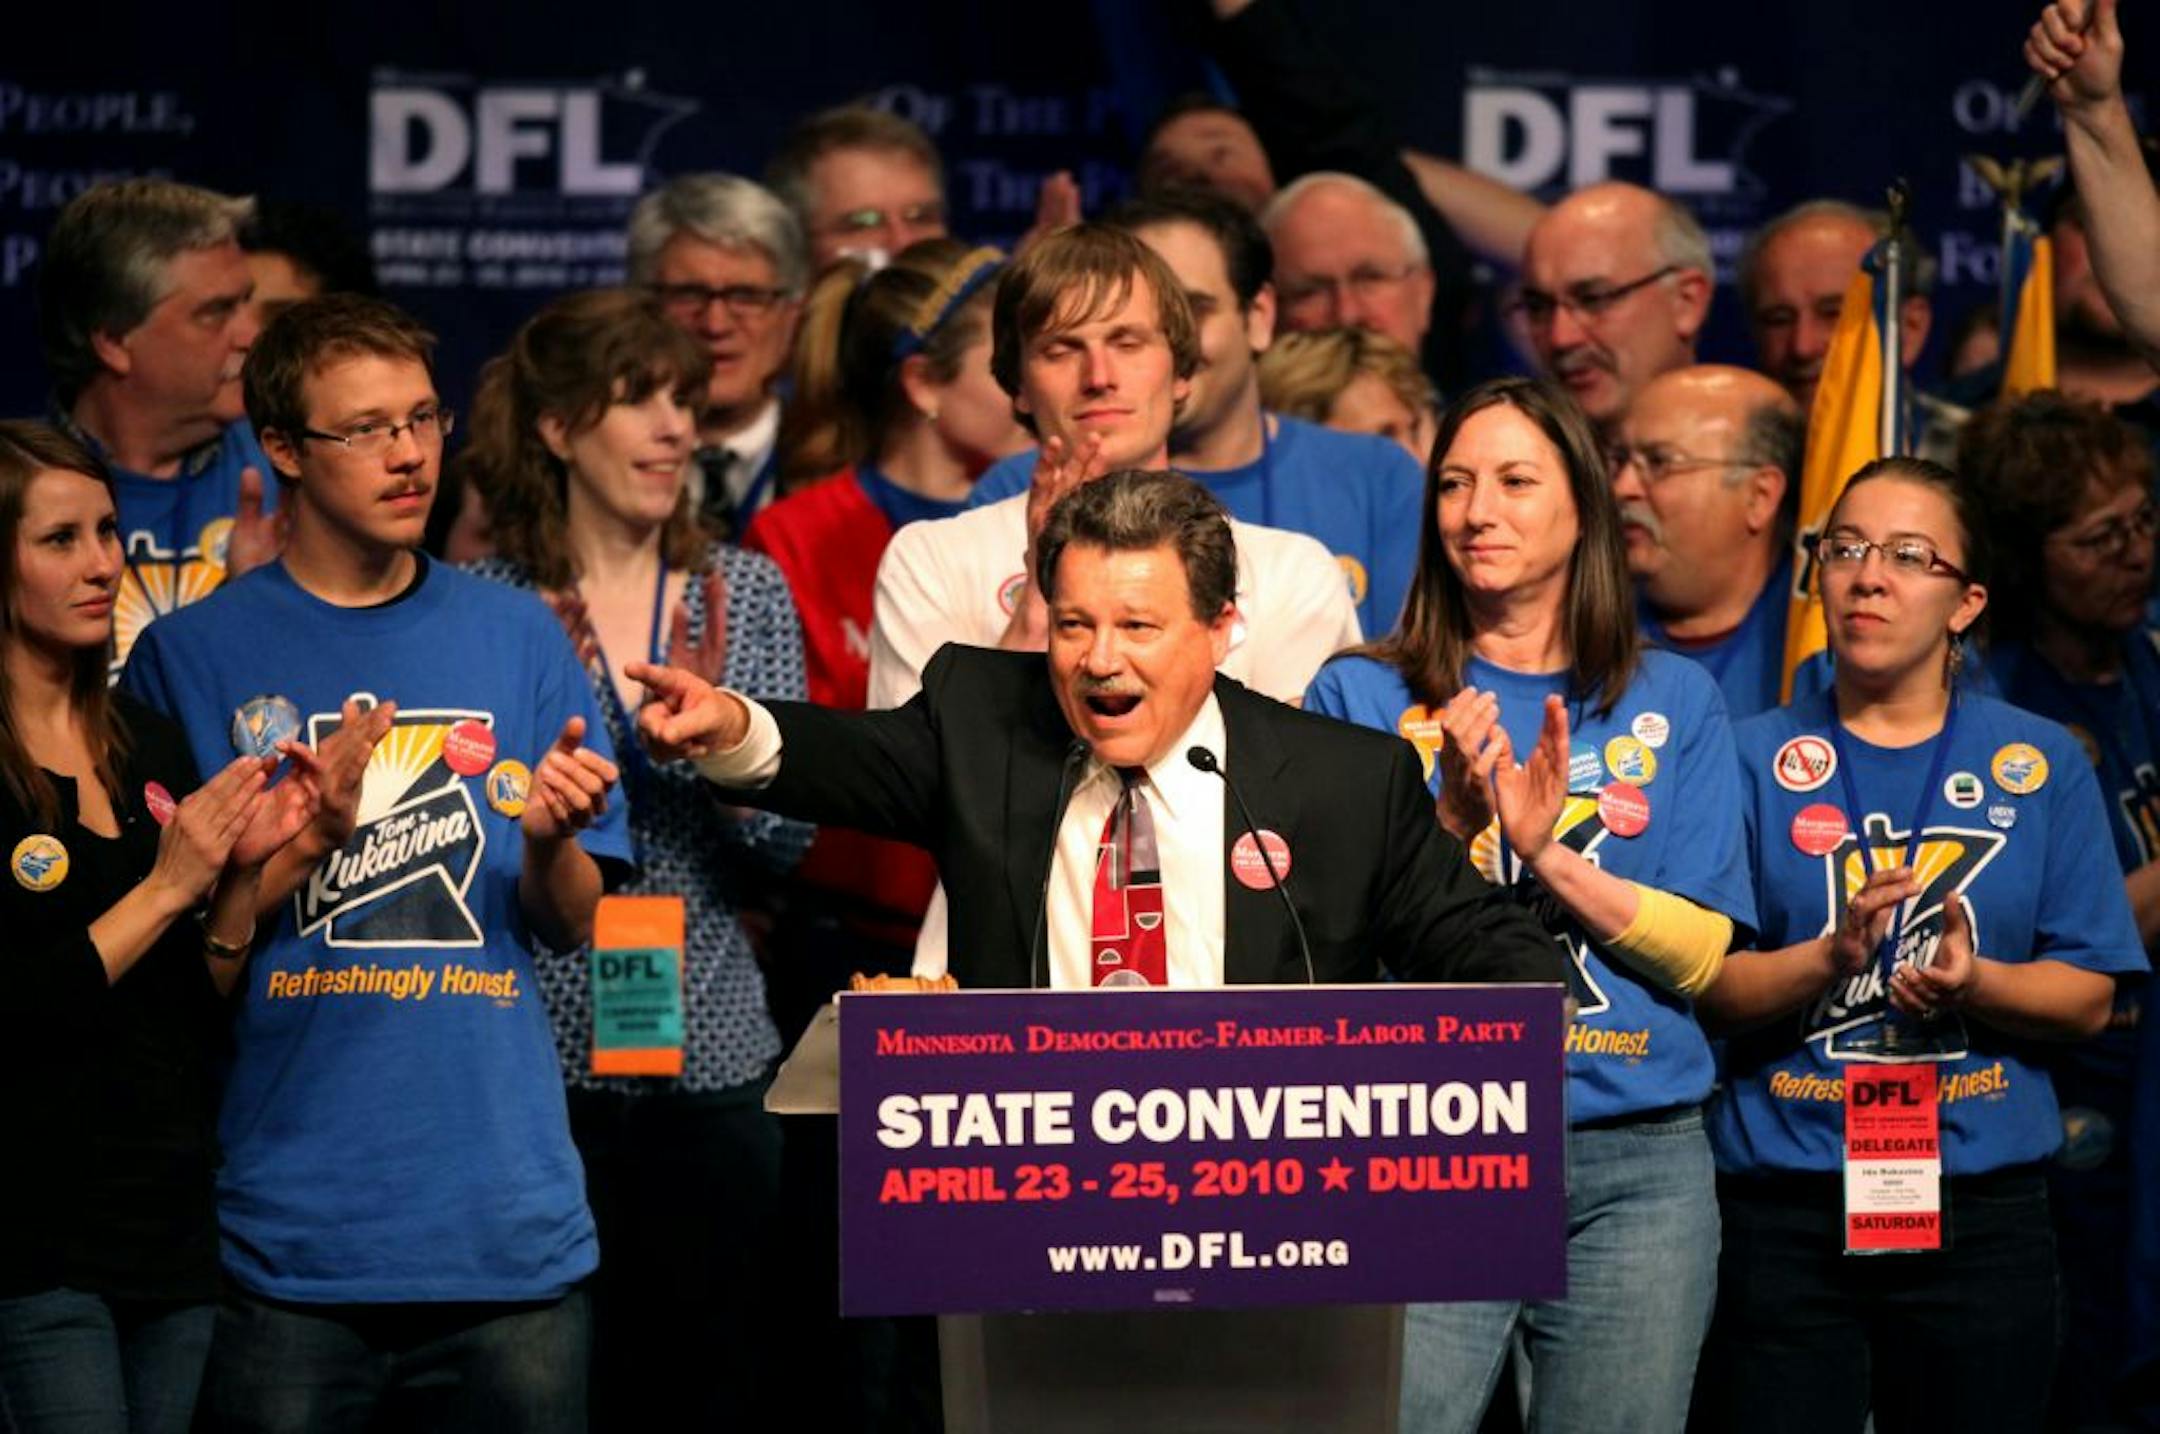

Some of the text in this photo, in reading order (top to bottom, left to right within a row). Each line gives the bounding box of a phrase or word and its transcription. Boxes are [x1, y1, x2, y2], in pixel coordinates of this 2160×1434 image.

[370, 88, 645, 195] DFL
[1464, 87, 1736, 195] DFL
[600, 955, 662, 980] DFL
[877, 1016, 1526, 1056] MINNESOTA DEMOCRATIC-FARMER-LABOR PARTY
[1853, 1081, 1921, 1107] DFL
[877, 1081, 1528, 1149] STATE CONVENTION
[1851, 1139, 1936, 1152] DELEGATE
[880, 1167, 1007, 1203] APRIL
[1015, 1164, 1072, 1201] 23
[1110, 1163, 1180, 1205] 25,
[1193, 1159, 1304, 1197] 2010
[1369, 1155, 1529, 1192] DULUTH
[1852, 1216, 1936, 1230] SATURDAY
